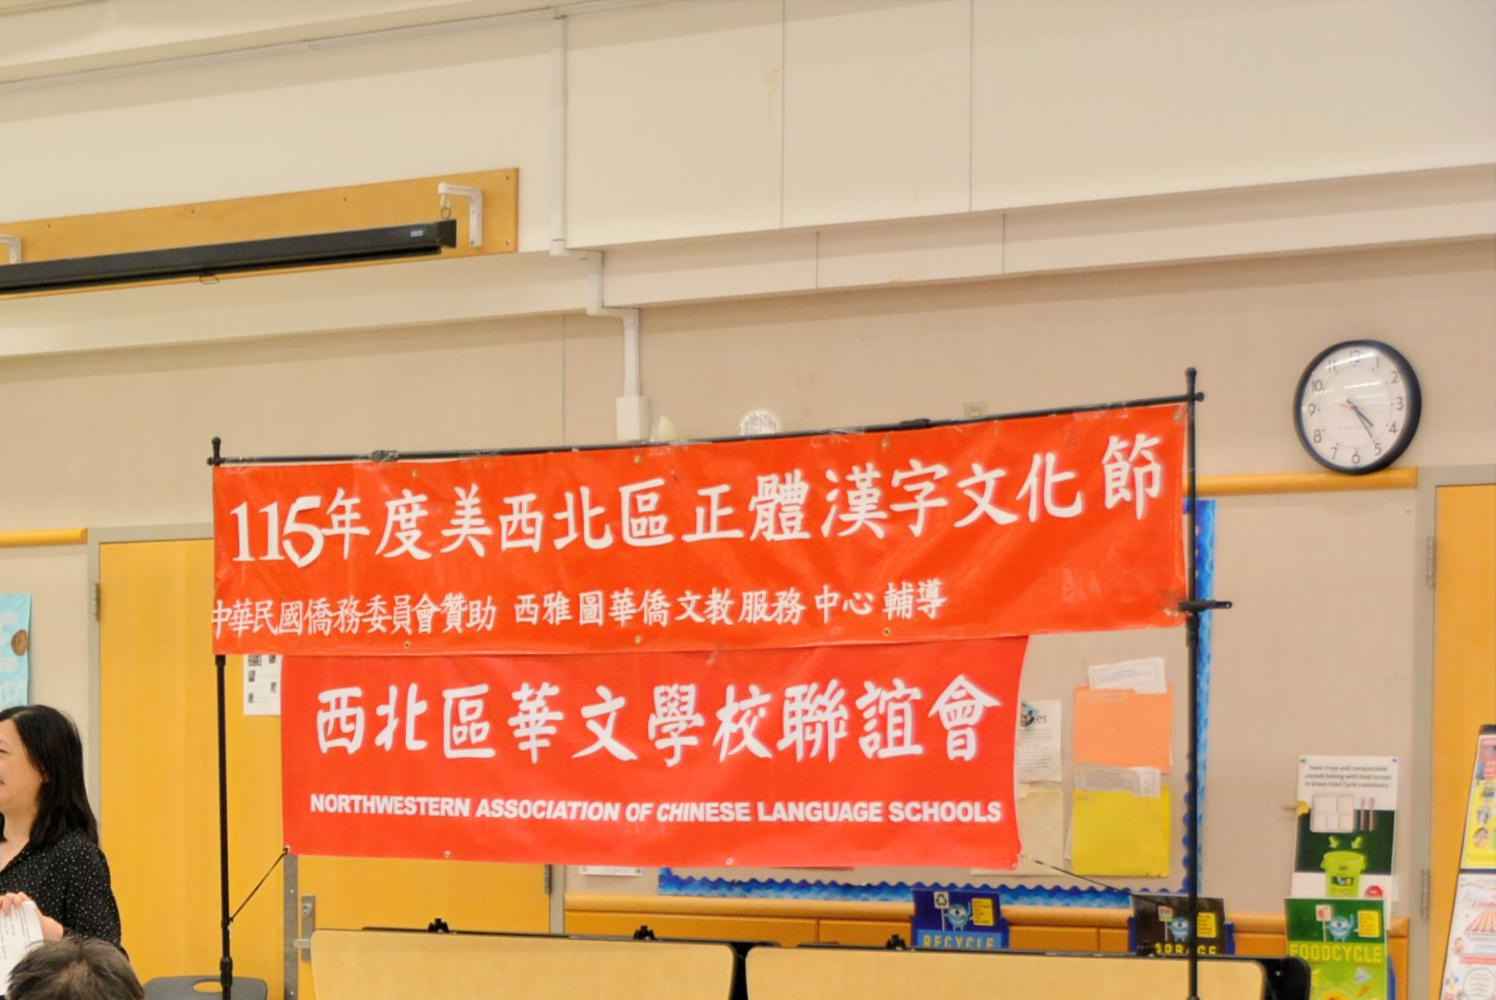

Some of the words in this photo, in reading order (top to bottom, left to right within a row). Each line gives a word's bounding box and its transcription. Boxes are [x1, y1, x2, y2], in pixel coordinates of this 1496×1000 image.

[1390, 371, 1399, 384] 2
[1311, 379, 1323, 392] 10
[1307, 403, 1316, 417] 9
[1395, 396, 1404, 411] 3
[1388, 421, 1398, 434] 4
[1313, 428, 1322, 444] 8
[1330, 446, 1339, 460] 7
[1351, 448, 1361, 464] 6
[1374, 442, 1383, 456] 5
[229, 432, 1163, 568] 115年度美西北區正體漢字文化節
[316, 674, 1001, 768] 西北區華文學校聯誼會
[310, 793, 471, 817] NORTHWESTERN
[475, 799, 621, 822] ASSOCIATION
[625, 802, 652, 823] OF
[656, 801, 751, 823] CHINESE
[757, 800, 883, 823] LANGUAGE
[888, 800, 1002, 823] SCHOOLS
[1289, 943, 1382, 963] FOODCYCLE
